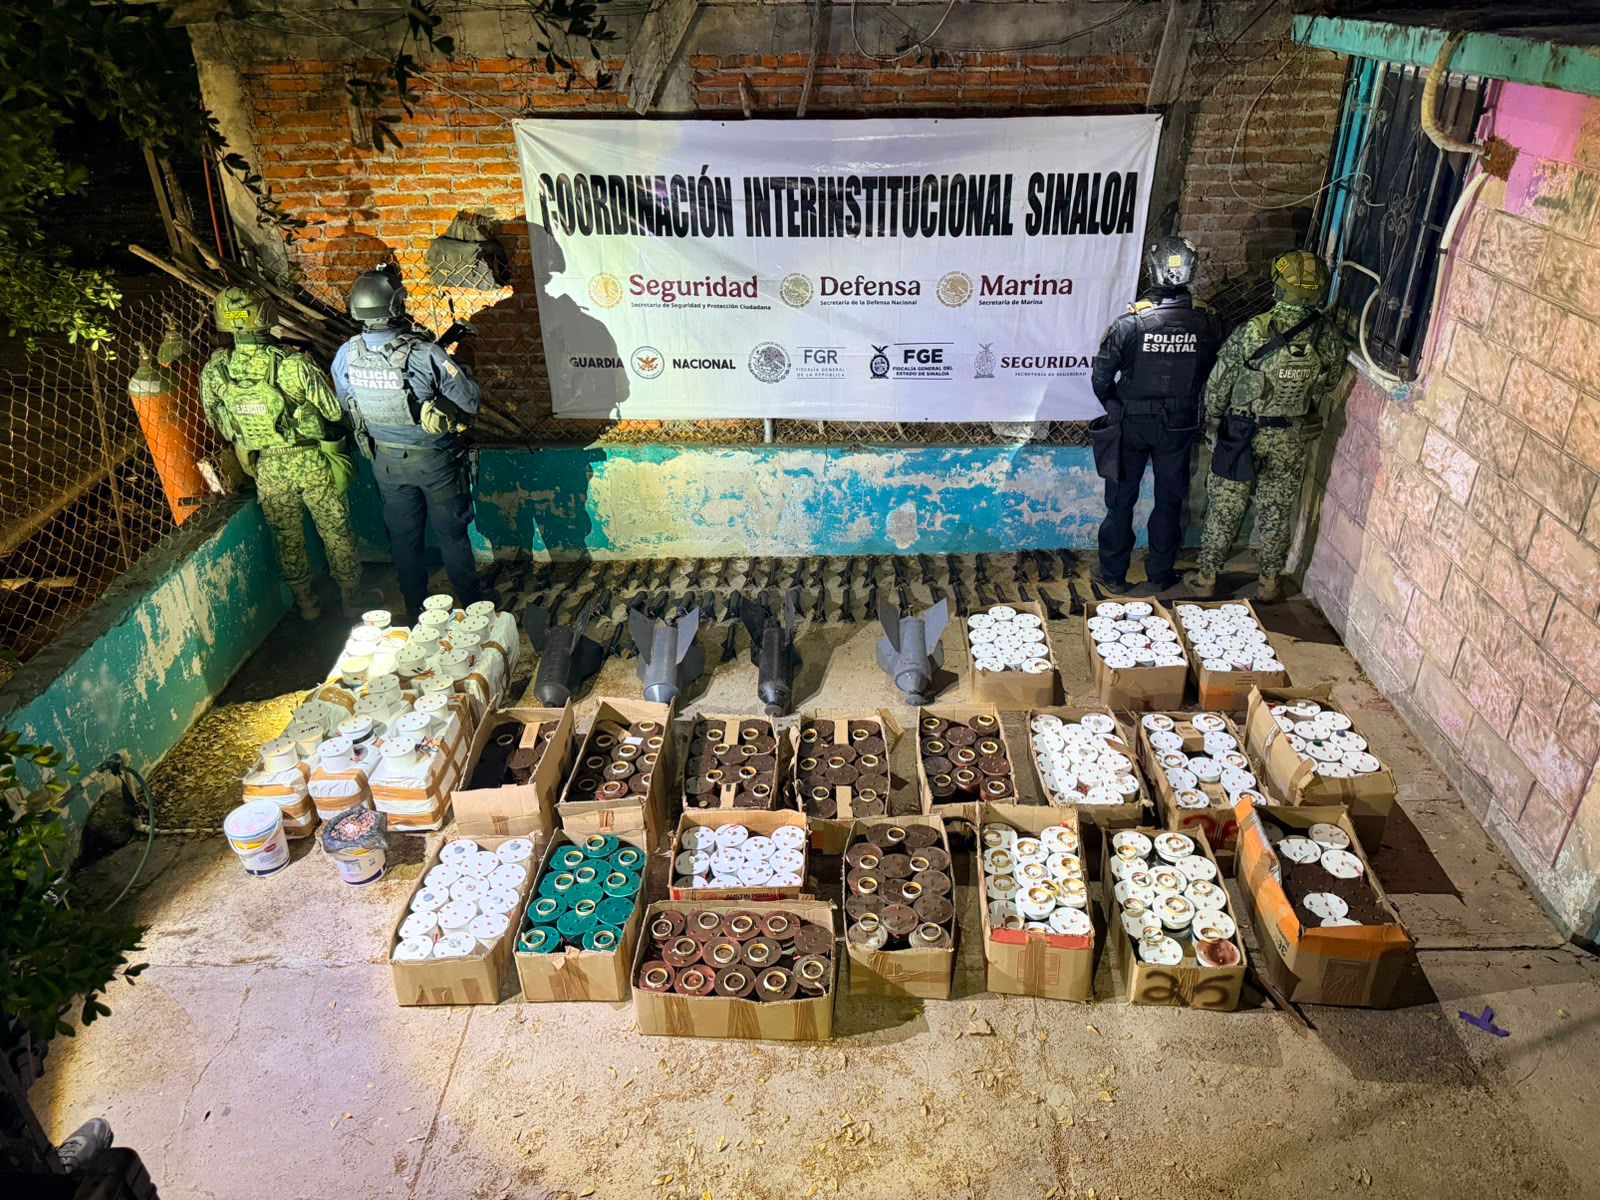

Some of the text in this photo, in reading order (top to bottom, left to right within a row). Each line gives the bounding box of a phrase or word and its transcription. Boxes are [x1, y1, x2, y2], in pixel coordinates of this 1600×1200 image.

[539, 165, 1138, 238] COORDINACIÓN INTERINSTITUCIONAL SINALOA
[629, 274, 758, 303] Seguridad
[820, 275, 920, 296] Defensa
[980, 273, 1073, 296] Marina
[1143, 332, 1198, 343] POLICÍA
[1142, 342, 1197, 353] ESTATAL
[569, 357, 625, 369] GUARDIA
[673, 359, 736, 370] NACIONAL
[804, 349, 838, 364] FGR
[904, 349, 943, 364] FGE
[350, 377, 402, 390] ESTATAL
